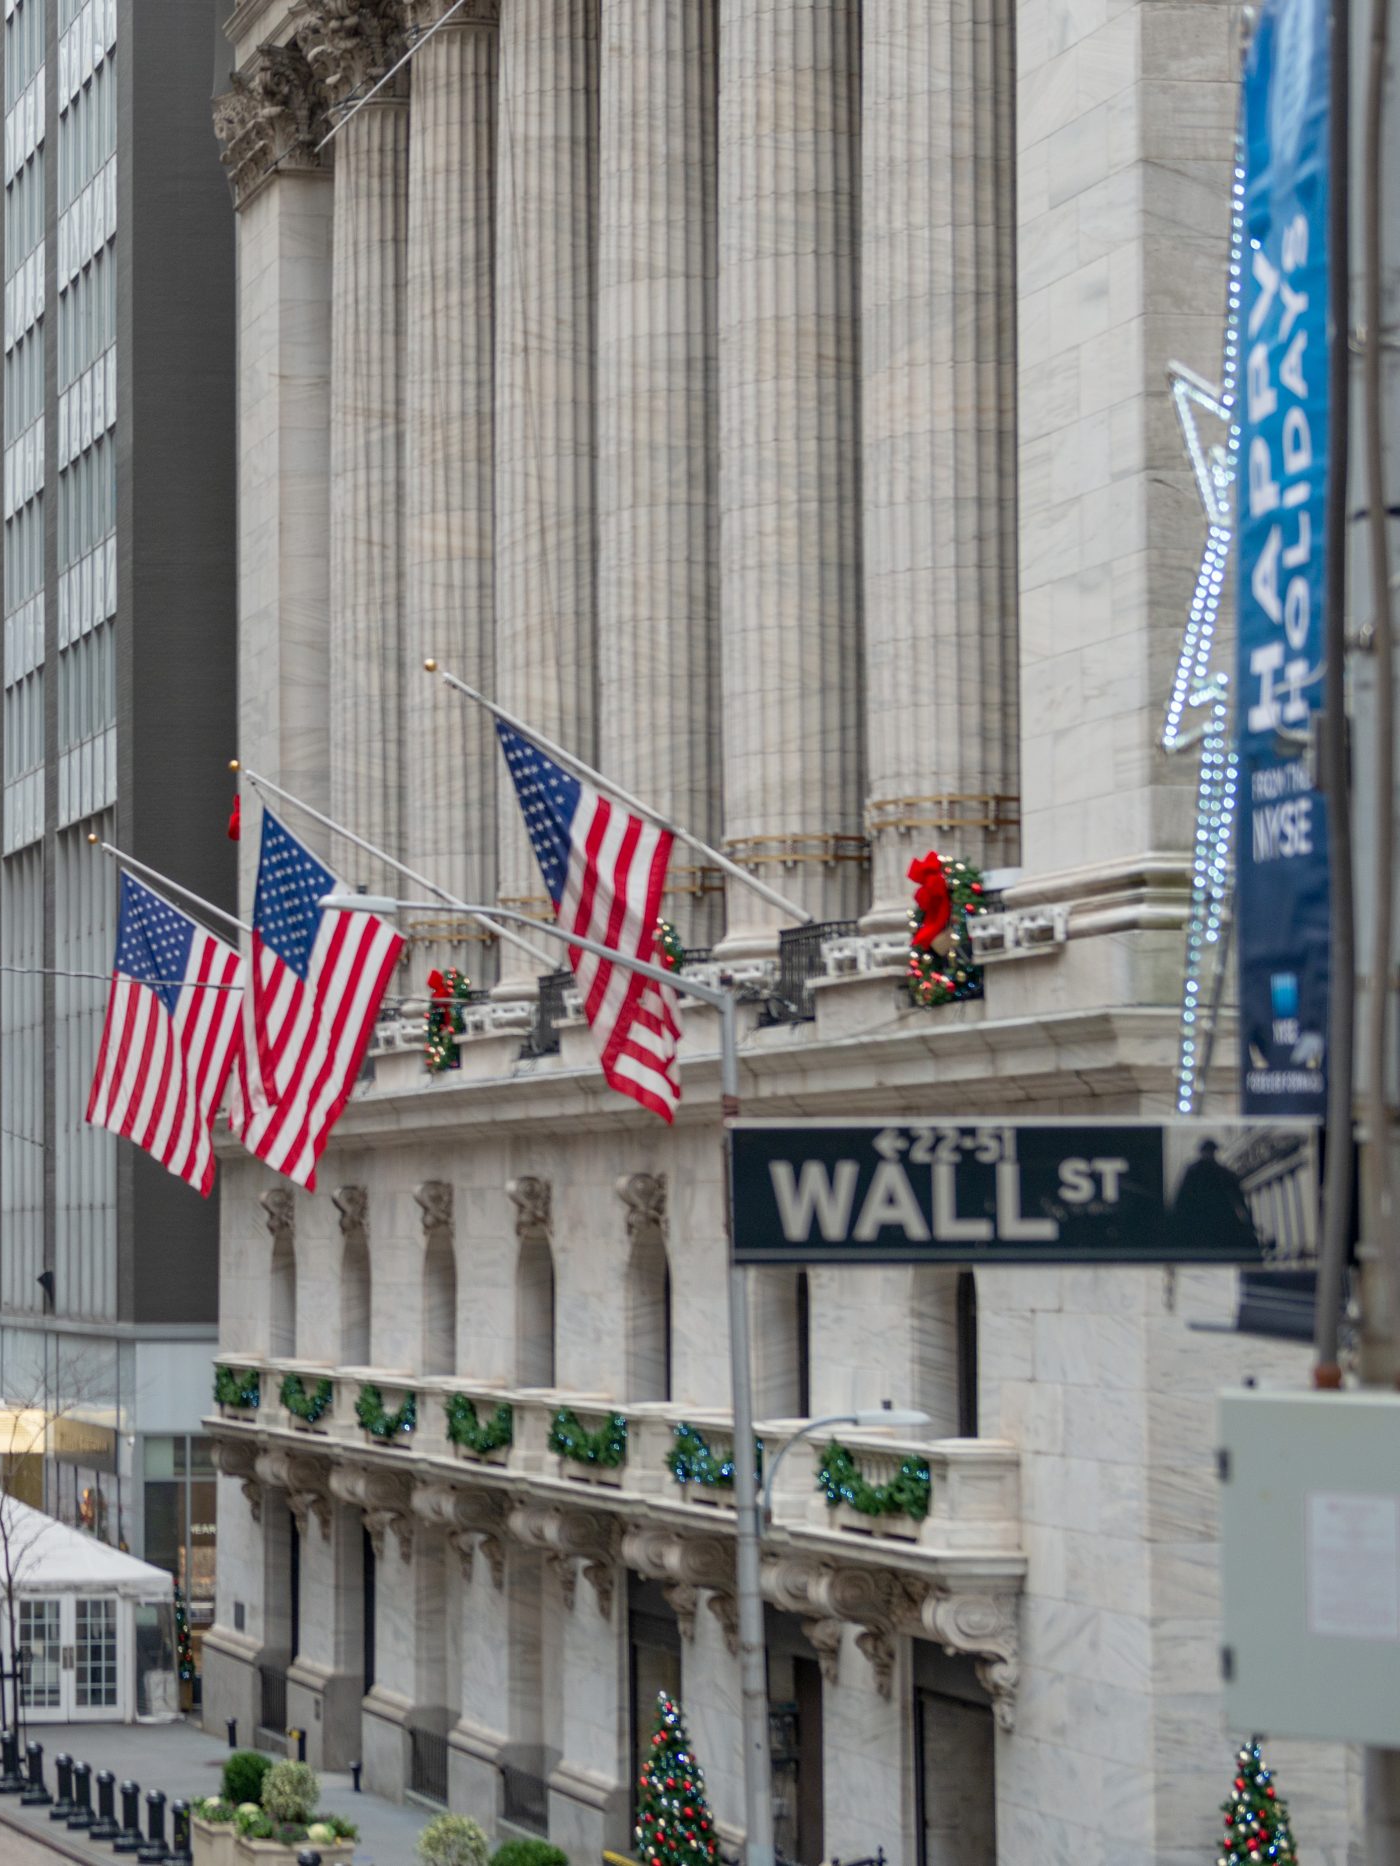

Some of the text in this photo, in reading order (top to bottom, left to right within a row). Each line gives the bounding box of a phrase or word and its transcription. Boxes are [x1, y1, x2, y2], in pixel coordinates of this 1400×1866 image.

[1247, 250, 1284, 734] HAPPY
[1278, 212, 1312, 723] HOLIDAYS
[1251, 796, 1313, 864] NYSE
[767, 1157, 1129, 1243] WALL ST
